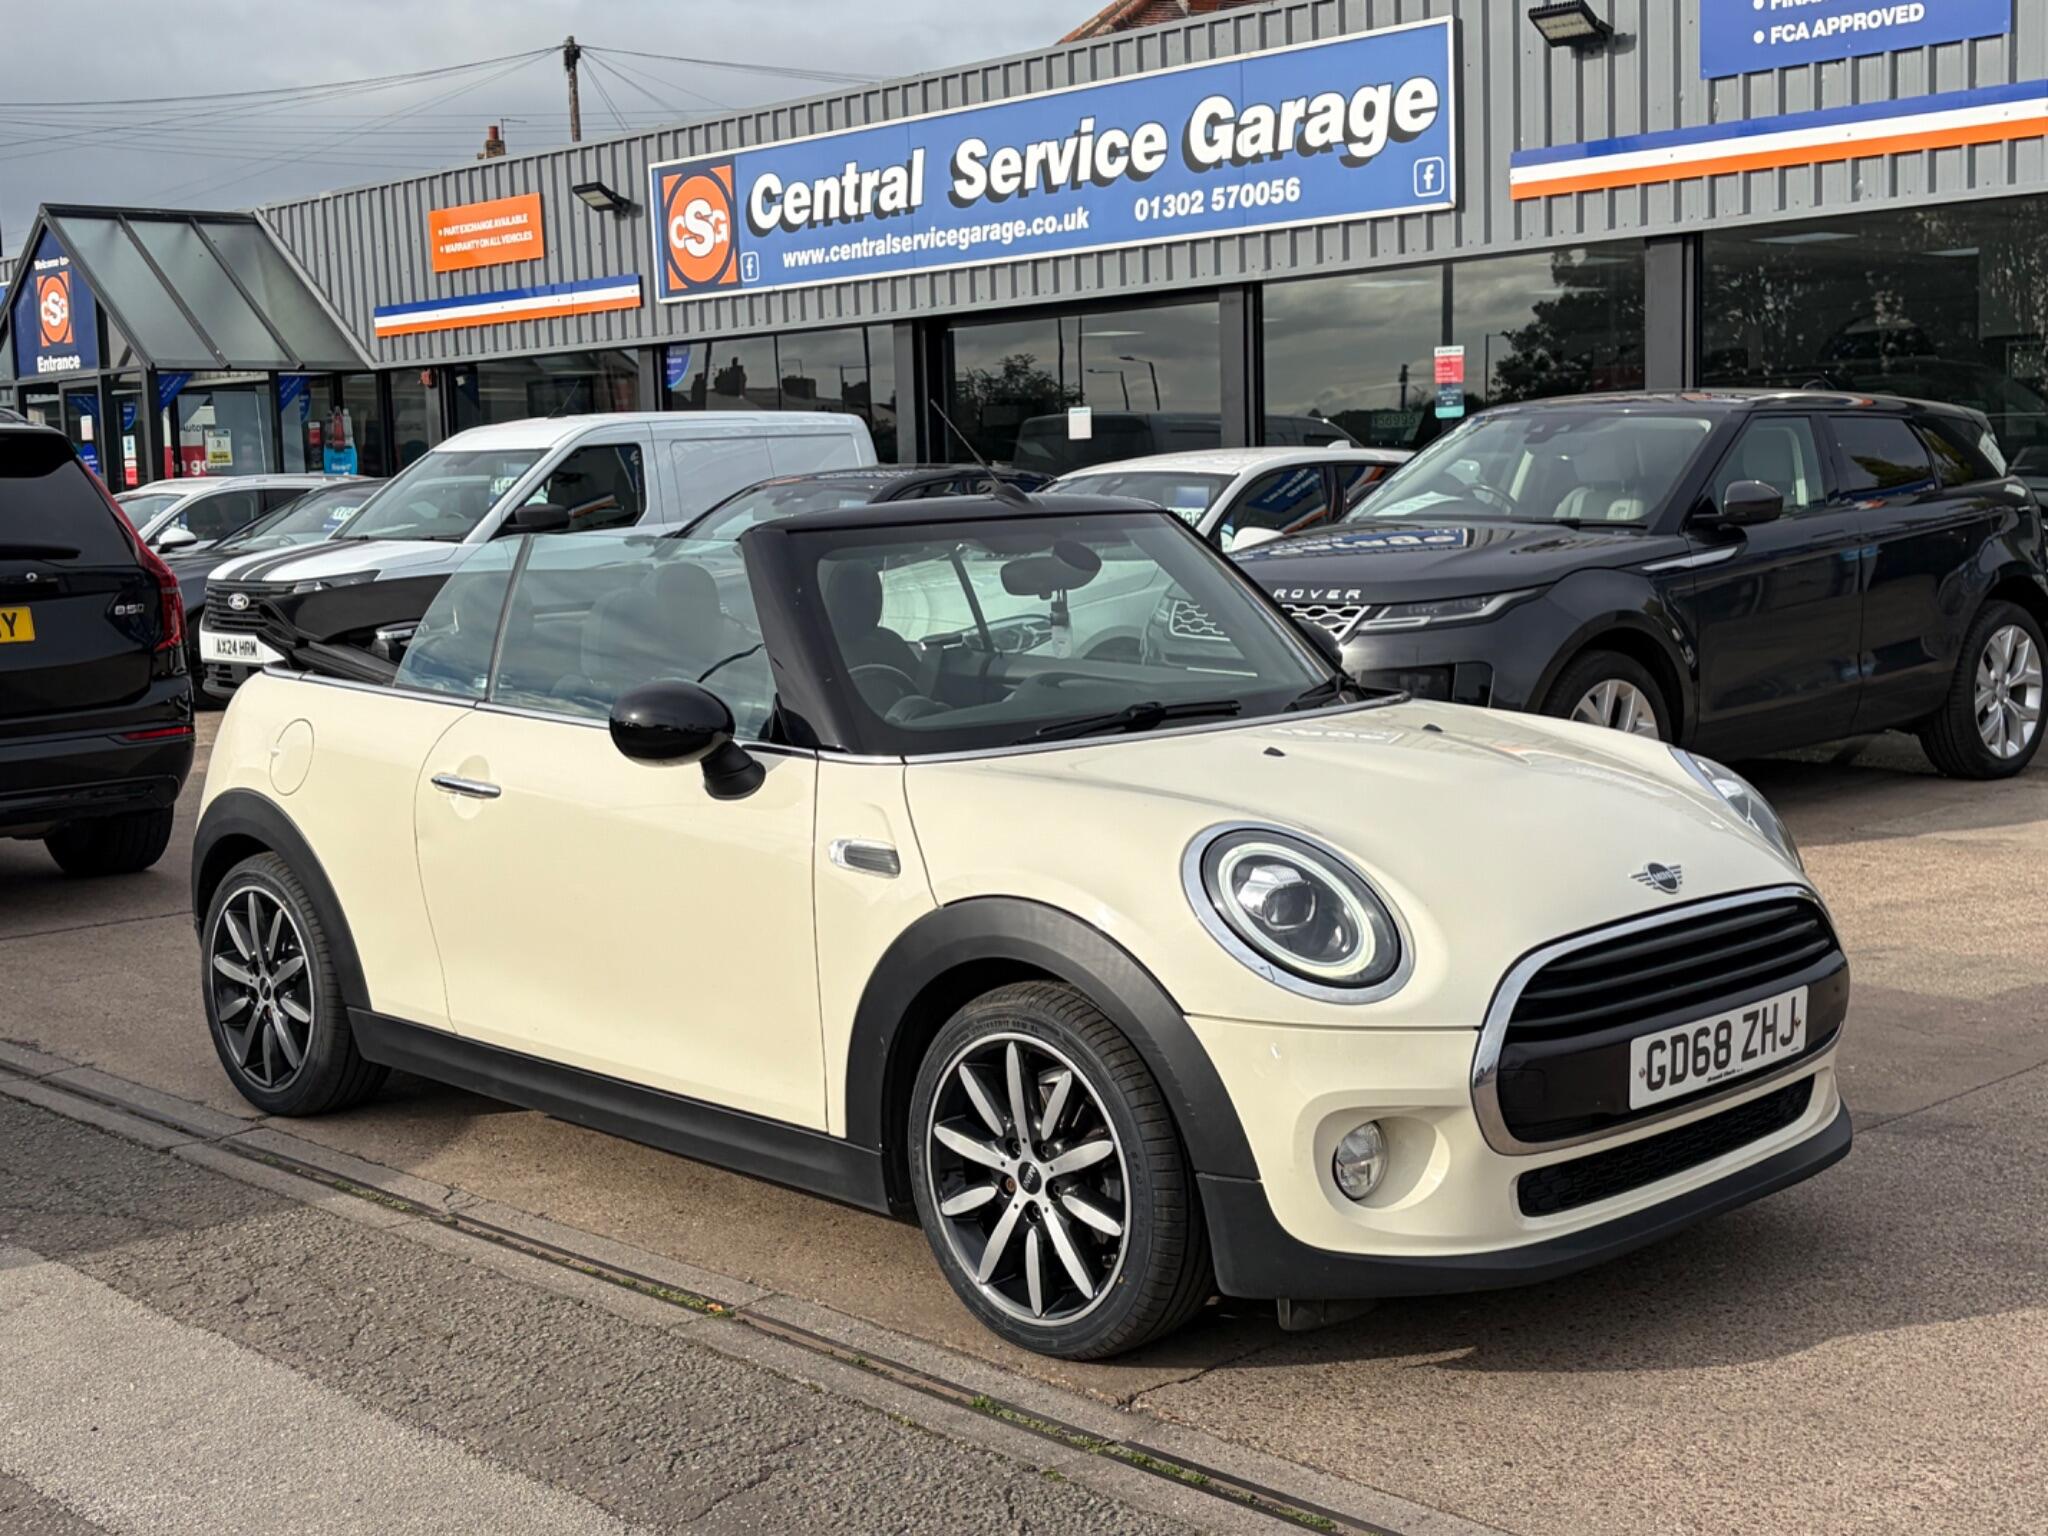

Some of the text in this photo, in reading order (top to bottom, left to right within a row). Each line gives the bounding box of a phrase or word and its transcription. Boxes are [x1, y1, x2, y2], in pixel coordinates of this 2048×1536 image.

[1770, 3, 1926, 45] FCA APPROVED
[748, 76, 1439, 232] Central Service Garage
[1134, 176, 1301, 222] 01302 570056
[443, 212, 529, 237] PART EXCHANGE AVAILABLE
[669, 197, 728, 258] CSG
[782, 206, 1090, 269] www.centralservicegarage.co.uk
[445, 230, 533, 254] WARRANTY ON ALL VEHICLES
[34, 258, 60, 270] Welcome
[36, 354, 81, 373] Entrance
[1272, 588, 1362, 600] ROVER
[216, 638, 258, 657] AX24 HRM
[1645, 996, 1797, 1092] GD68 ZHJ
